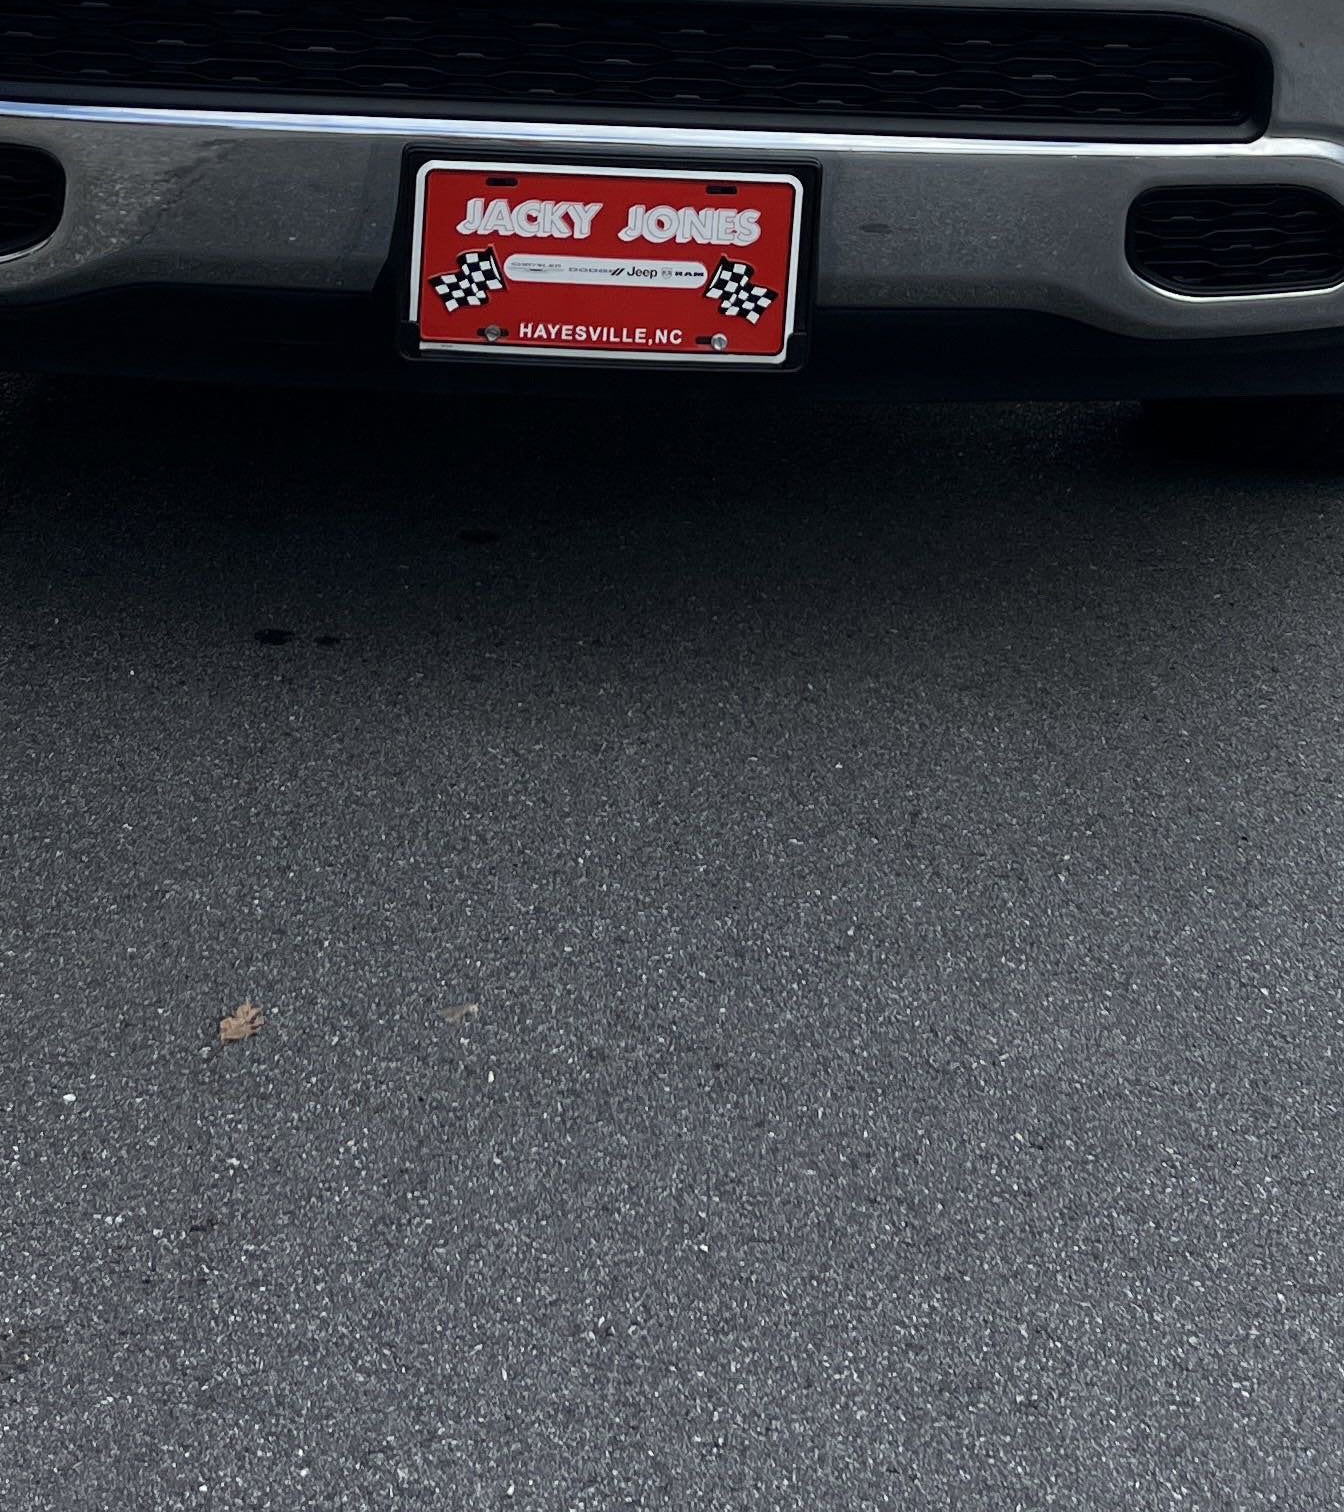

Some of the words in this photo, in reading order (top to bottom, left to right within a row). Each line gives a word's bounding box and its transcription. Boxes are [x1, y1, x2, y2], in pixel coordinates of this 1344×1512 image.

[456, 197, 604, 239] JACKY
[617, 204, 762, 247] JONES
[626, 266, 658, 279] Jeep
